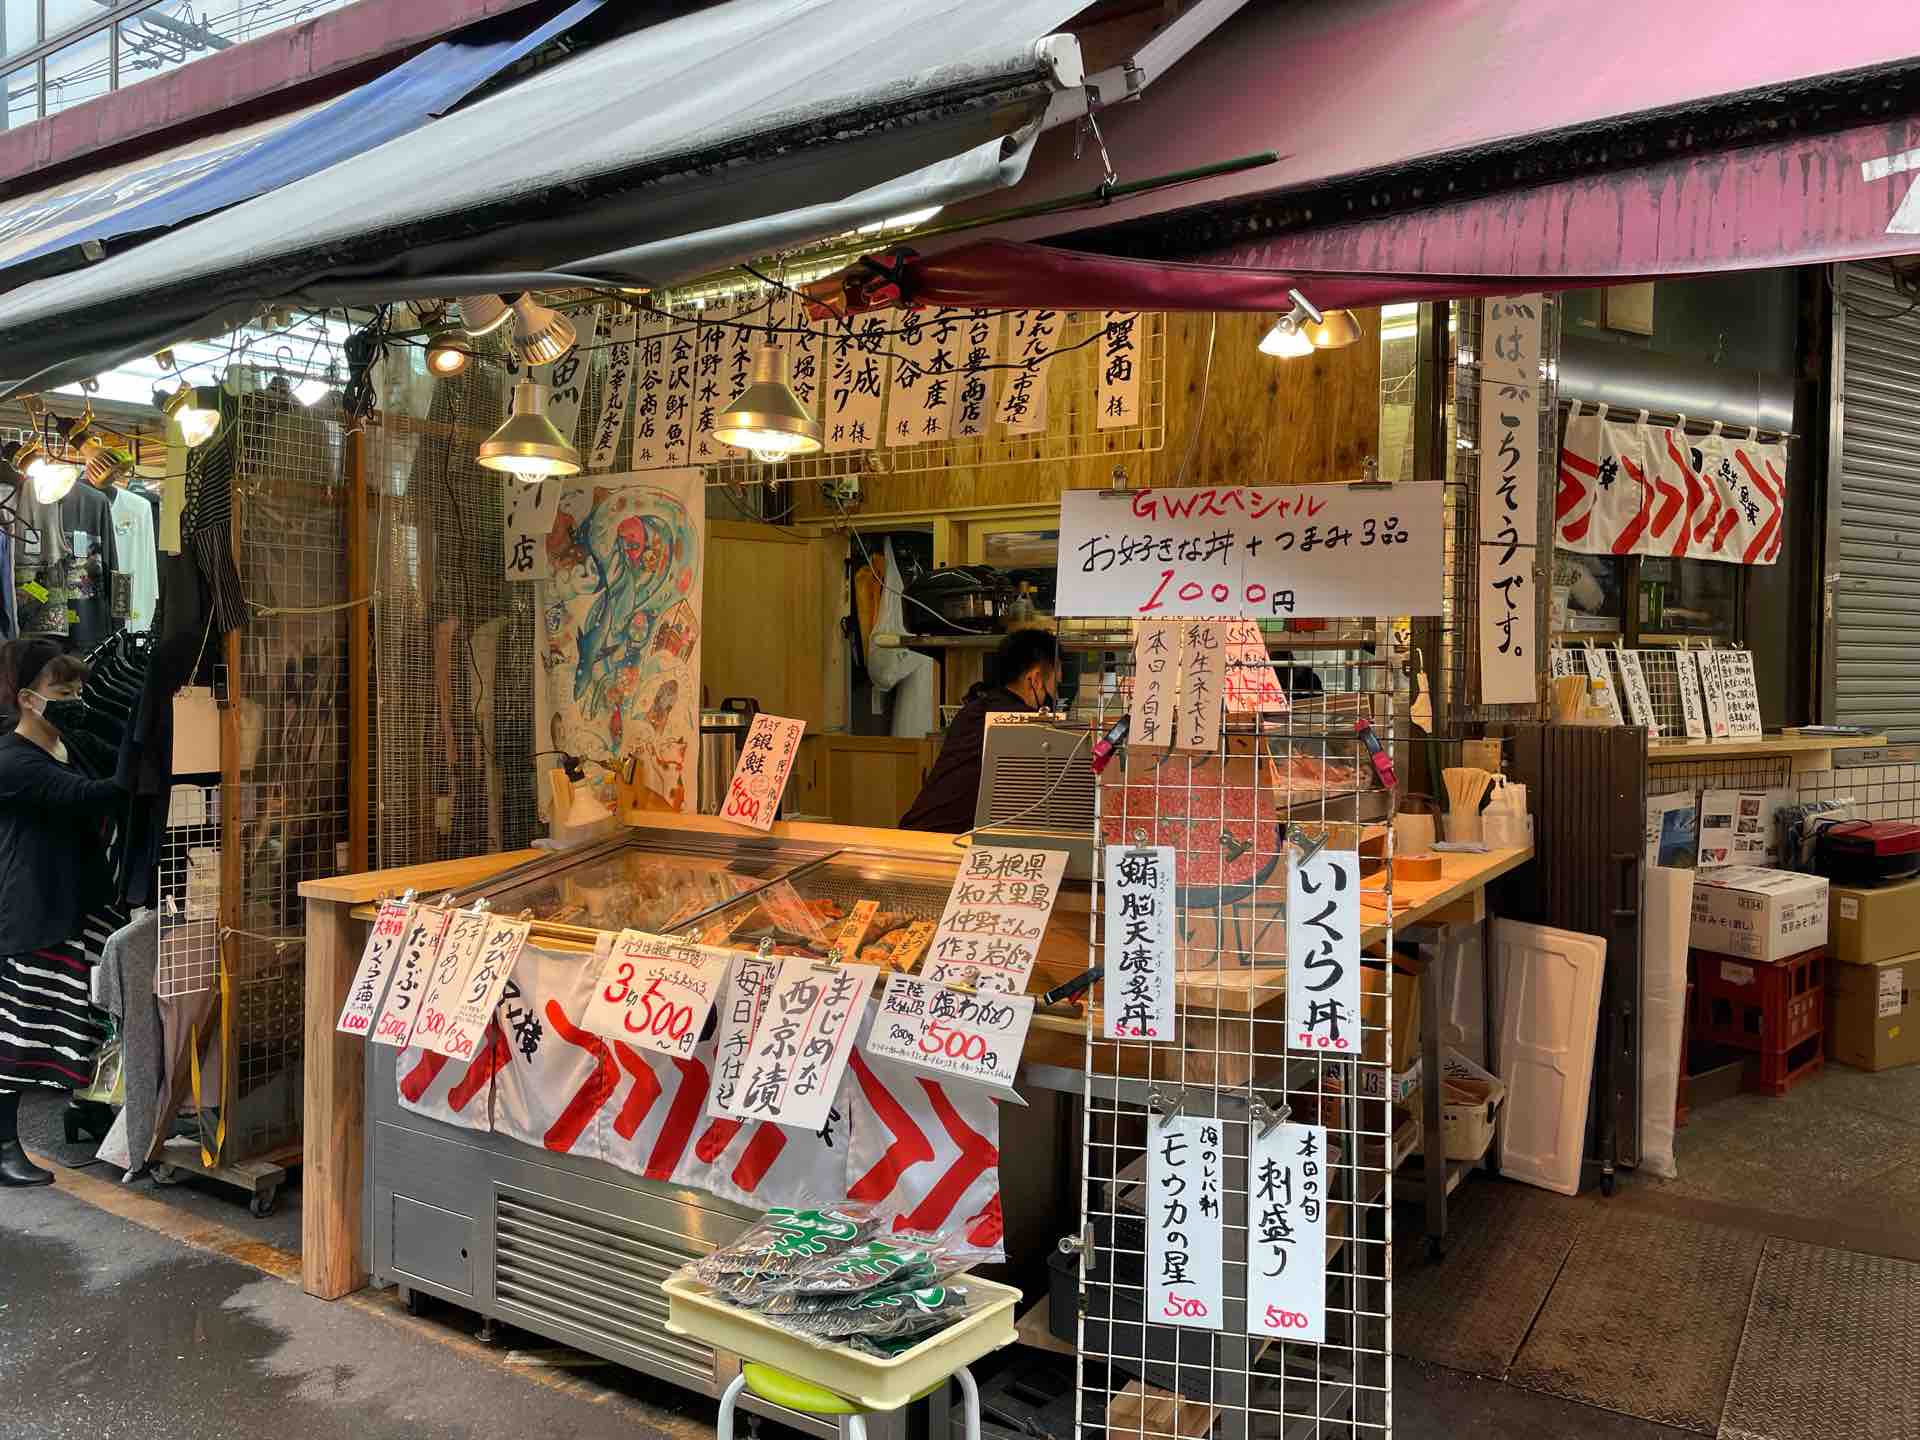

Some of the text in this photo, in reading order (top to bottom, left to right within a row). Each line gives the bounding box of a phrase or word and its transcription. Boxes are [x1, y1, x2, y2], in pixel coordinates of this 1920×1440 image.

[1133, 489, 1329, 521] GWスペシャル
[1299, 862, 1348, 1042] いくら丼
[1298, 1033, 1349, 1050] 700
[1295, 1130, 1321, 1223] 本日の旬
[1160, 1132, 1197, 1287] モウカの星
[1255, 1156, 1297, 1277] 刺盛り
[1163, 1291, 1209, 1318] 500
[1263, 1303, 1310, 1329] 500
